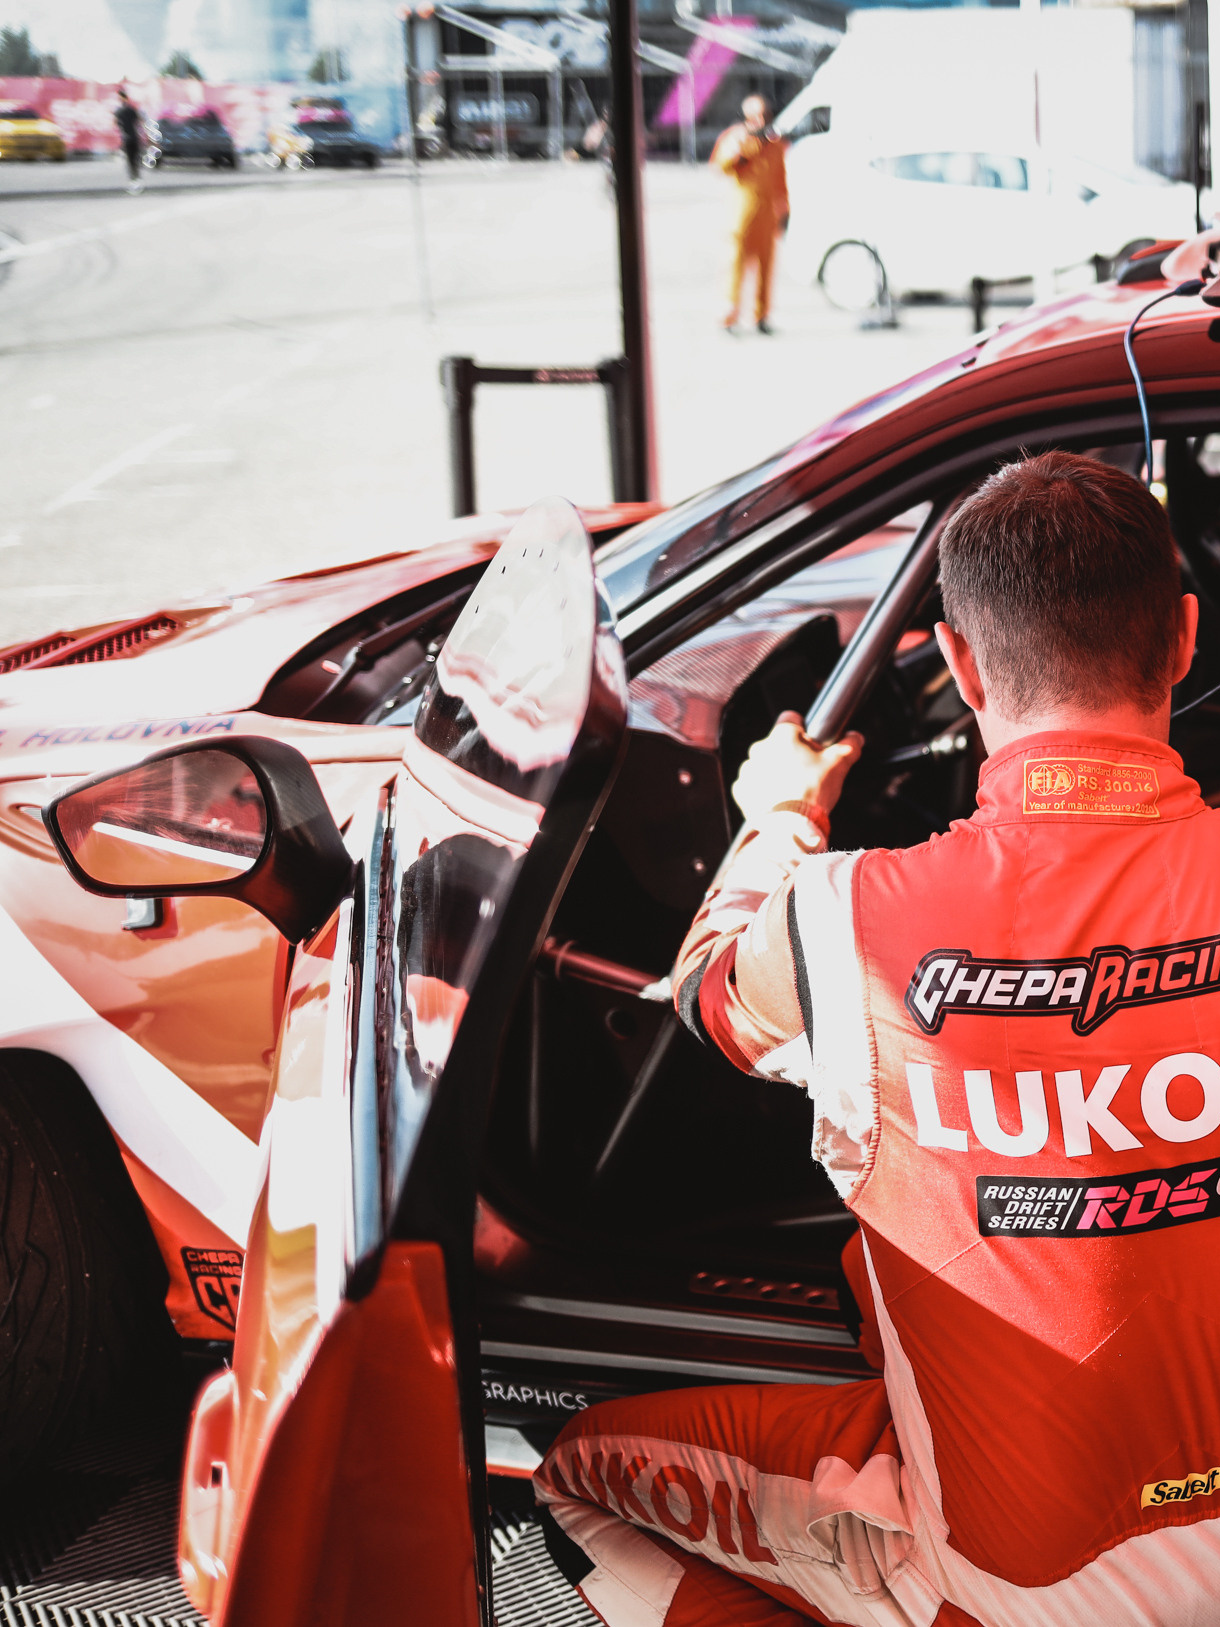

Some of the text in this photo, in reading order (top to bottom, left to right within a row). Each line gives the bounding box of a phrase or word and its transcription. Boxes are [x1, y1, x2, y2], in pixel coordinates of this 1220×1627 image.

[18, 716, 237, 748] HOLOVNIA
[1077, 764, 1152, 780] Standard 8856-2000
[1029, 801, 1051, 810] Year
[1054, 800, 1065, 810] of
[983, 1186, 1072, 1200] RUSSIAN
[1076, 1168, 1218, 1230] RDS
[1005, 1200, 1067, 1215] DRIFT
[988, 1216, 1059, 1230] SERIES
[186, 1251, 240, 1264] CHEPA
[1150, 1470, 1220, 1504] Sabelt
